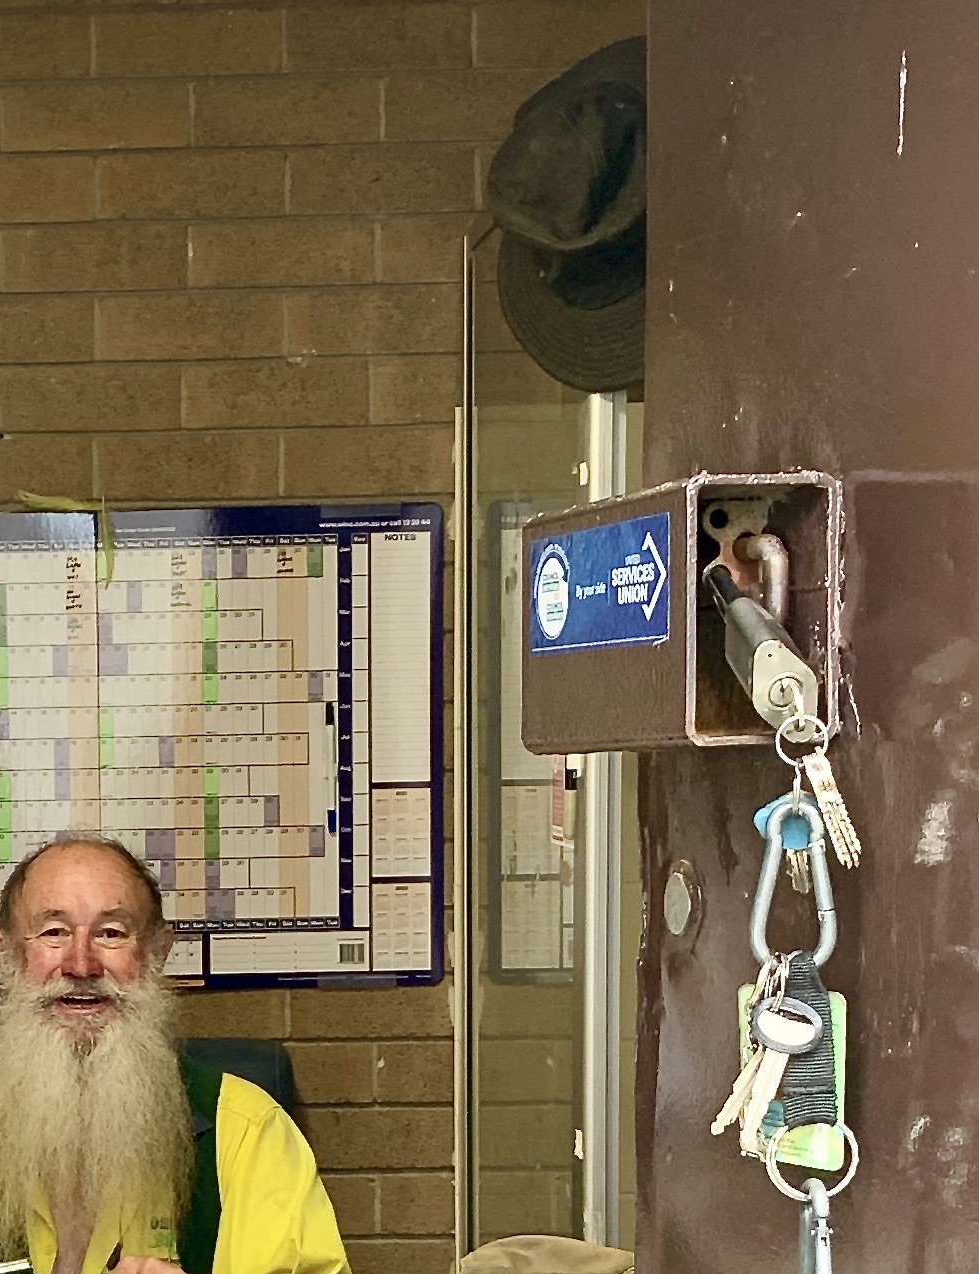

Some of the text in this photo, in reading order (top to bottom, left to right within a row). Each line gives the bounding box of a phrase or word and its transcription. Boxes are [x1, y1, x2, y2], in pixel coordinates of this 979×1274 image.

[384, 533, 417, 541] NOTES
[611, 561, 655, 588] SERVICES
[582, 585, 595, 600] your
[594, 581, 606, 595] side
[617, 583, 649, 605] UNION
